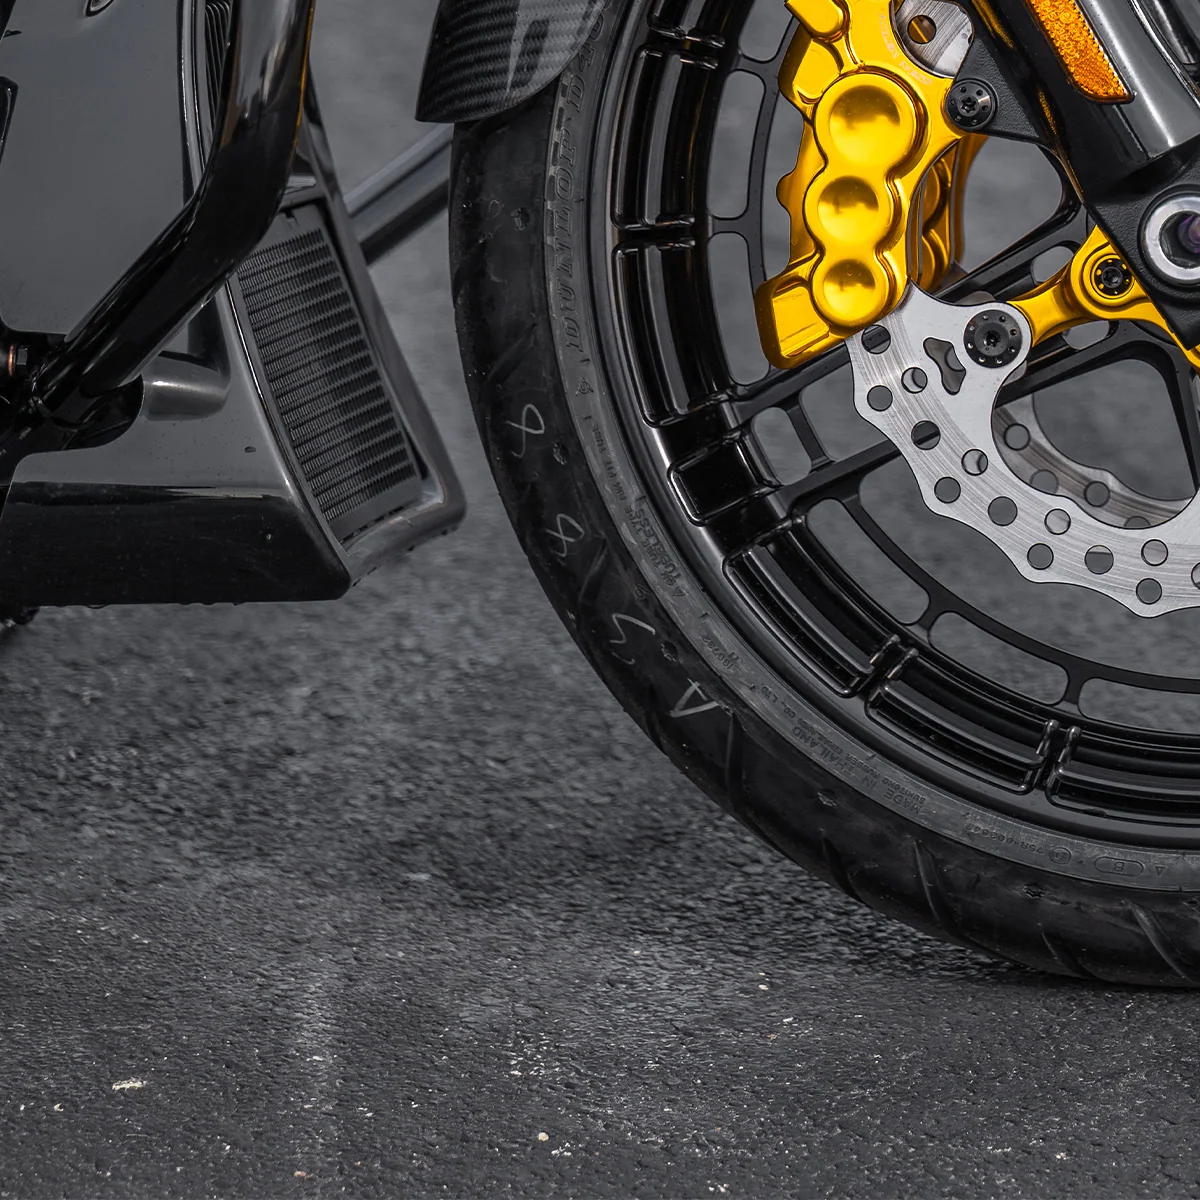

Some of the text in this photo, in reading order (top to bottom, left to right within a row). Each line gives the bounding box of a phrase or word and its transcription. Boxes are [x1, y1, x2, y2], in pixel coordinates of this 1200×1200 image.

[555, 127, 581, 355] DUNLOP
[633, 506, 682, 583] TUBELESS
[790, 723, 923, 816] MADE IN THAILAND
[1111, 860, 1125, 872] B
